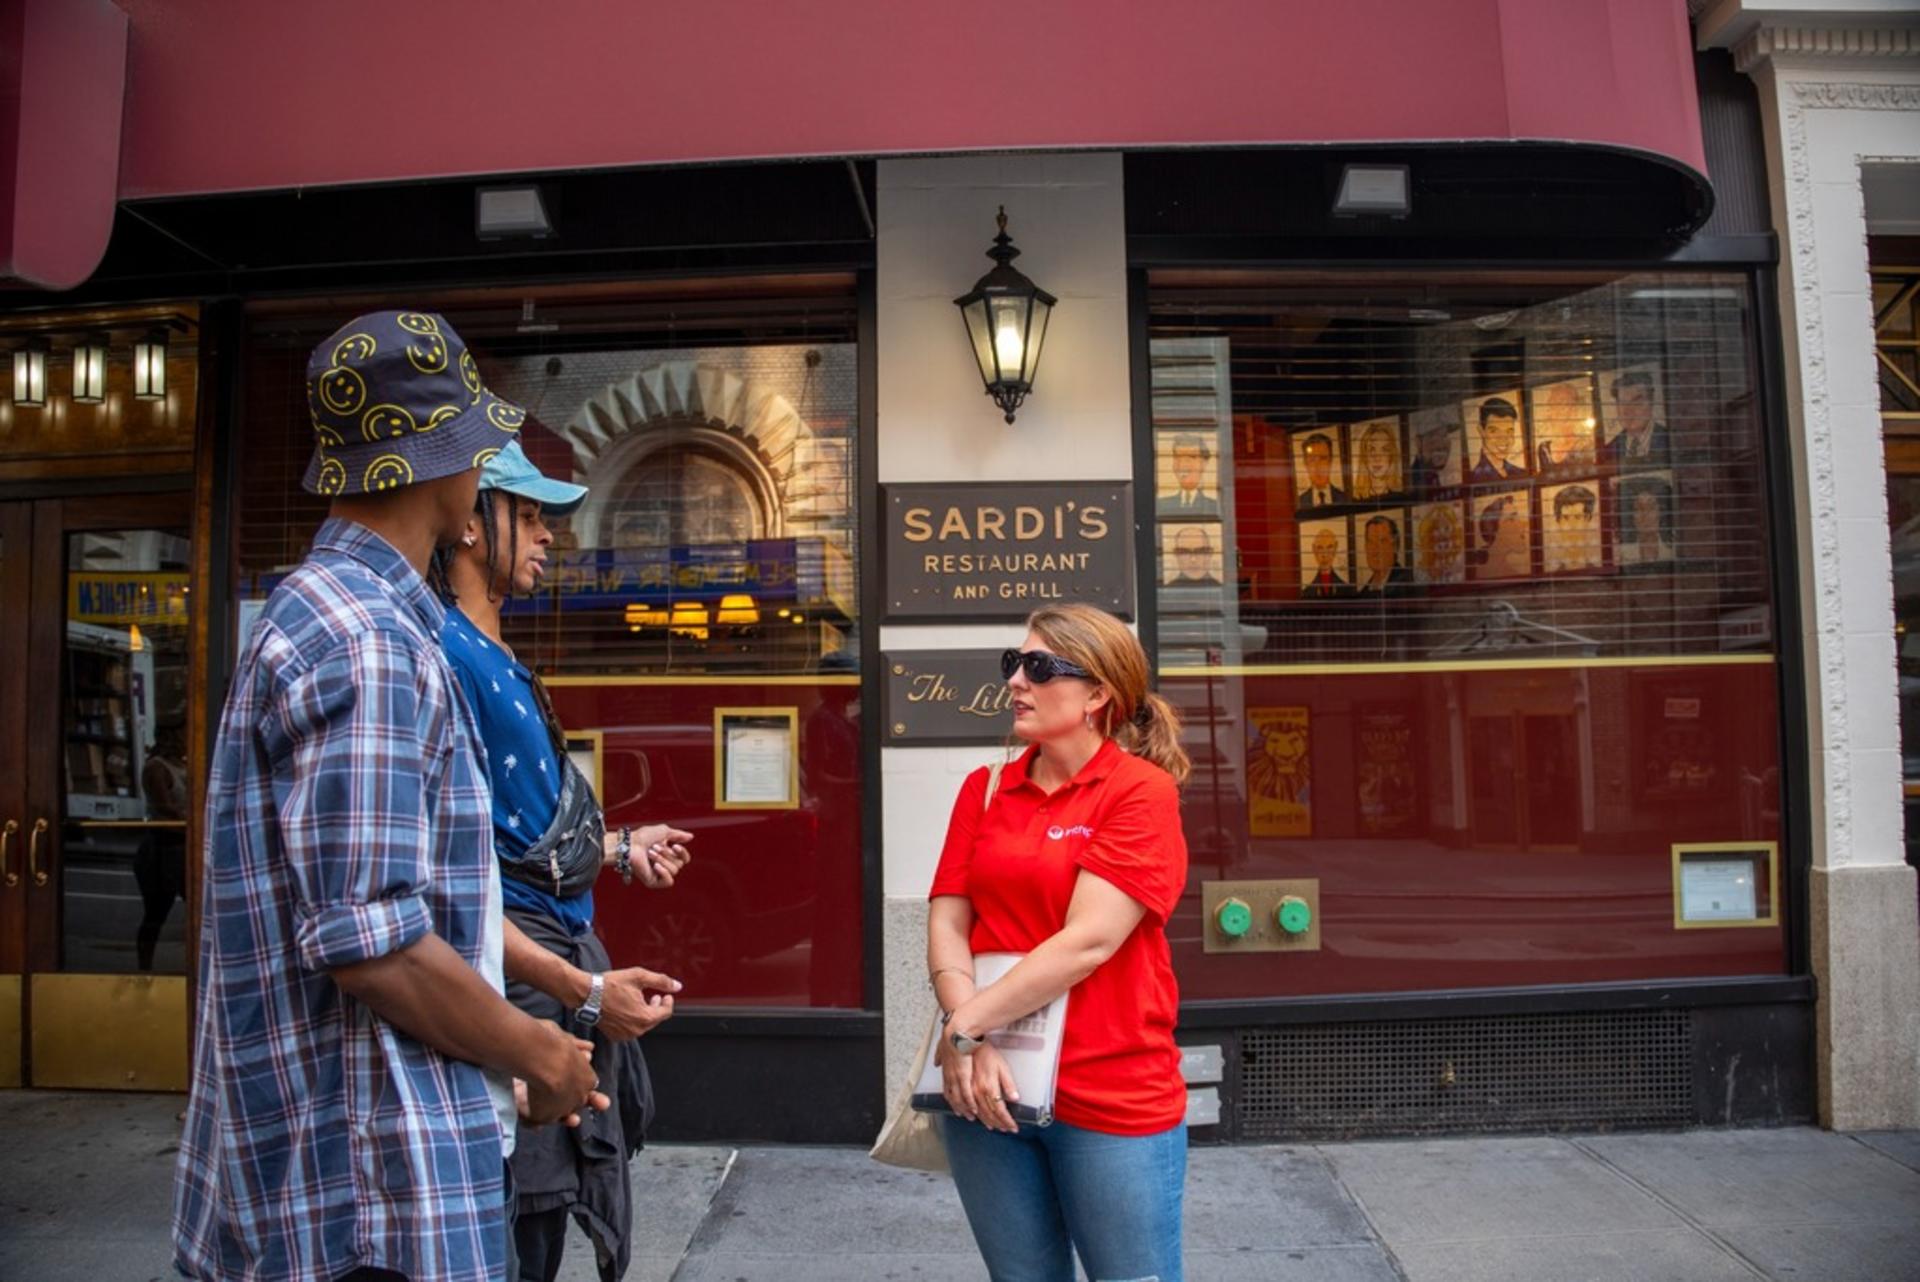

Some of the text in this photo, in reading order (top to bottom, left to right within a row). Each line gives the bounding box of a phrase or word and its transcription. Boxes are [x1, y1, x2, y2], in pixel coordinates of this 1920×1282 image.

[903, 501, 1108, 542] SARDI'S
[924, 553, 1090, 573] RESTAURANT
[953, 582, 1063, 599] AND GRILL
[907, 674, 959, 702] The
